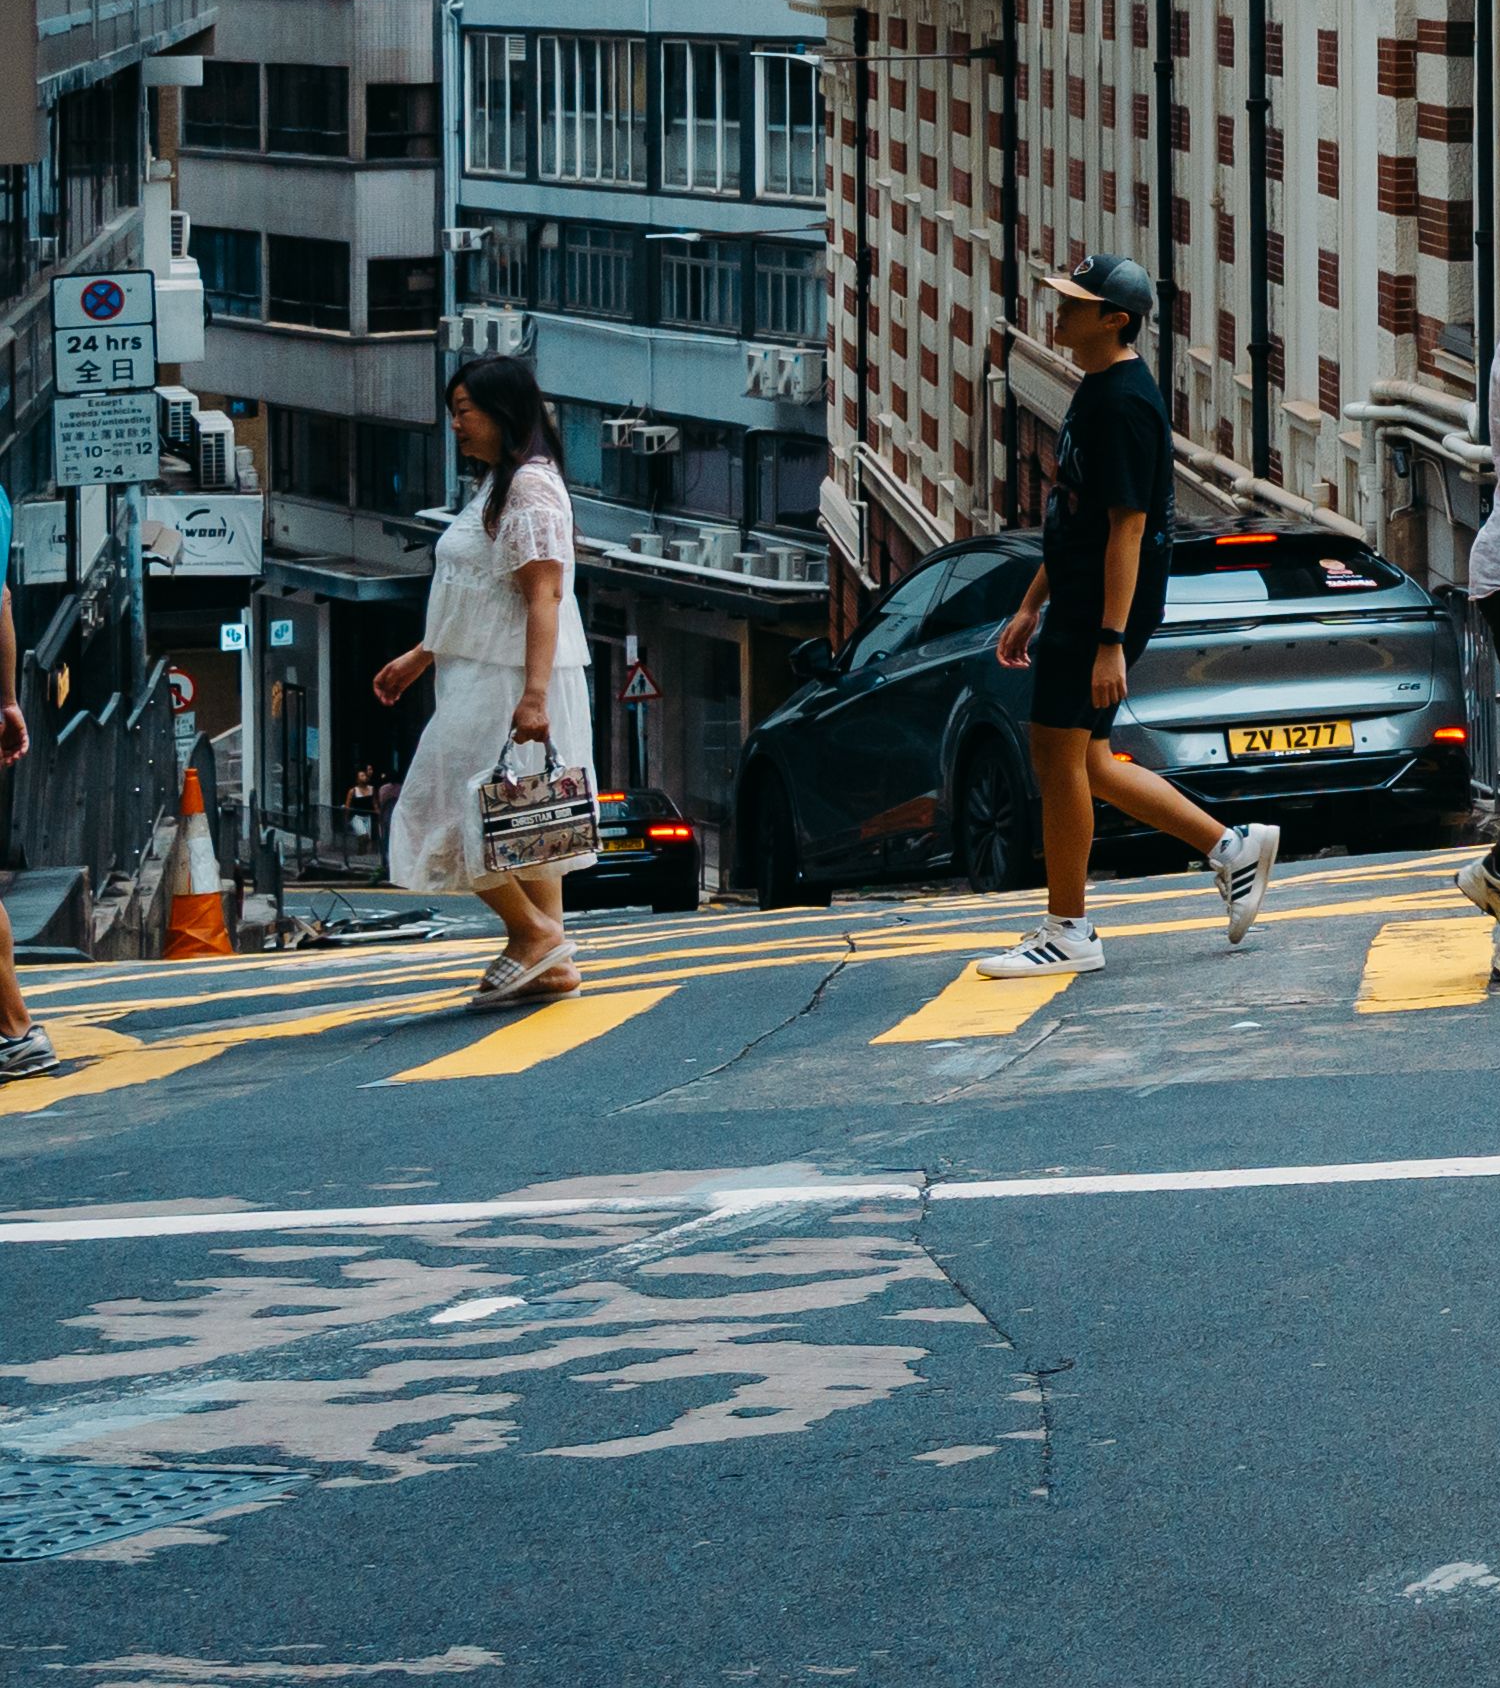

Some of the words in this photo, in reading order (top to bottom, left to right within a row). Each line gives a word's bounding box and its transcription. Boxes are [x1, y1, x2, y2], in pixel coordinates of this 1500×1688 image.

[67, 335, 99, 354] 24
[106, 335, 142, 351] hrs
[75, 358, 134, 384] 全日
[136, 442, 153, 455] 12
[1397, 682, 1421, 691] G6
[1244, 730, 1274, 752] ZV
[1282, 724, 1338, 750] 1277
[511, 813, 552, 828] CHRISTIAN
